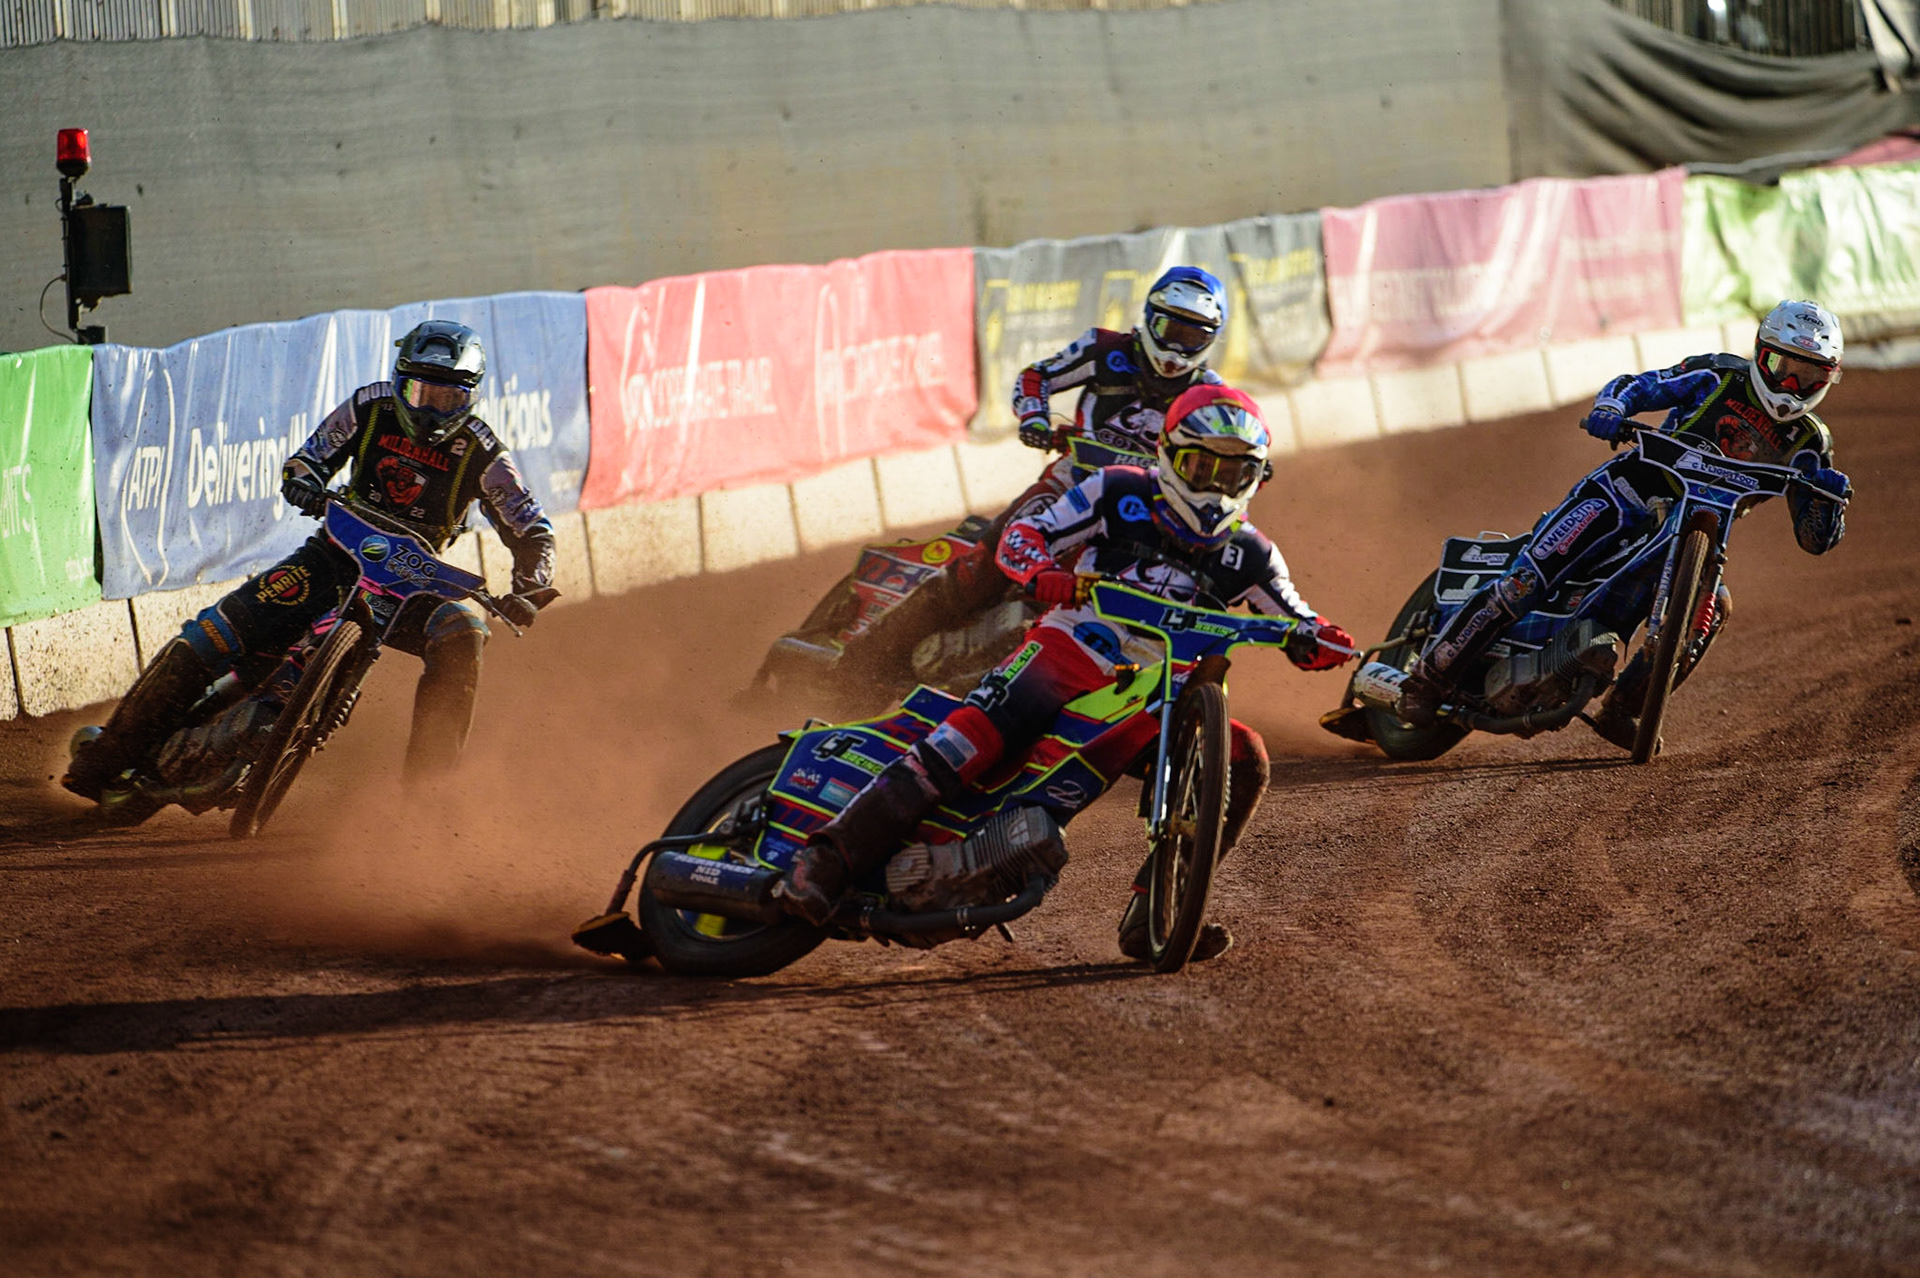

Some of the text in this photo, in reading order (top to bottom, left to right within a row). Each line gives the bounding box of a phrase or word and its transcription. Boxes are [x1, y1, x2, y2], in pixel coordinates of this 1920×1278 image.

[1796, 313, 1823, 326] Arai
[1724, 398, 1782, 450] MILDENHALL
[1785, 426, 1799, 442] 1
[451, 437, 468, 456] 2
[188, 416, 288, 522] Delivering
[368, 490, 382, 502] 20
[409, 506, 425, 519] 22
[391, 544, 438, 578] ZOG
[1225, 545, 1240, 567] 3
[255, 565, 311, 603] PENRITE
